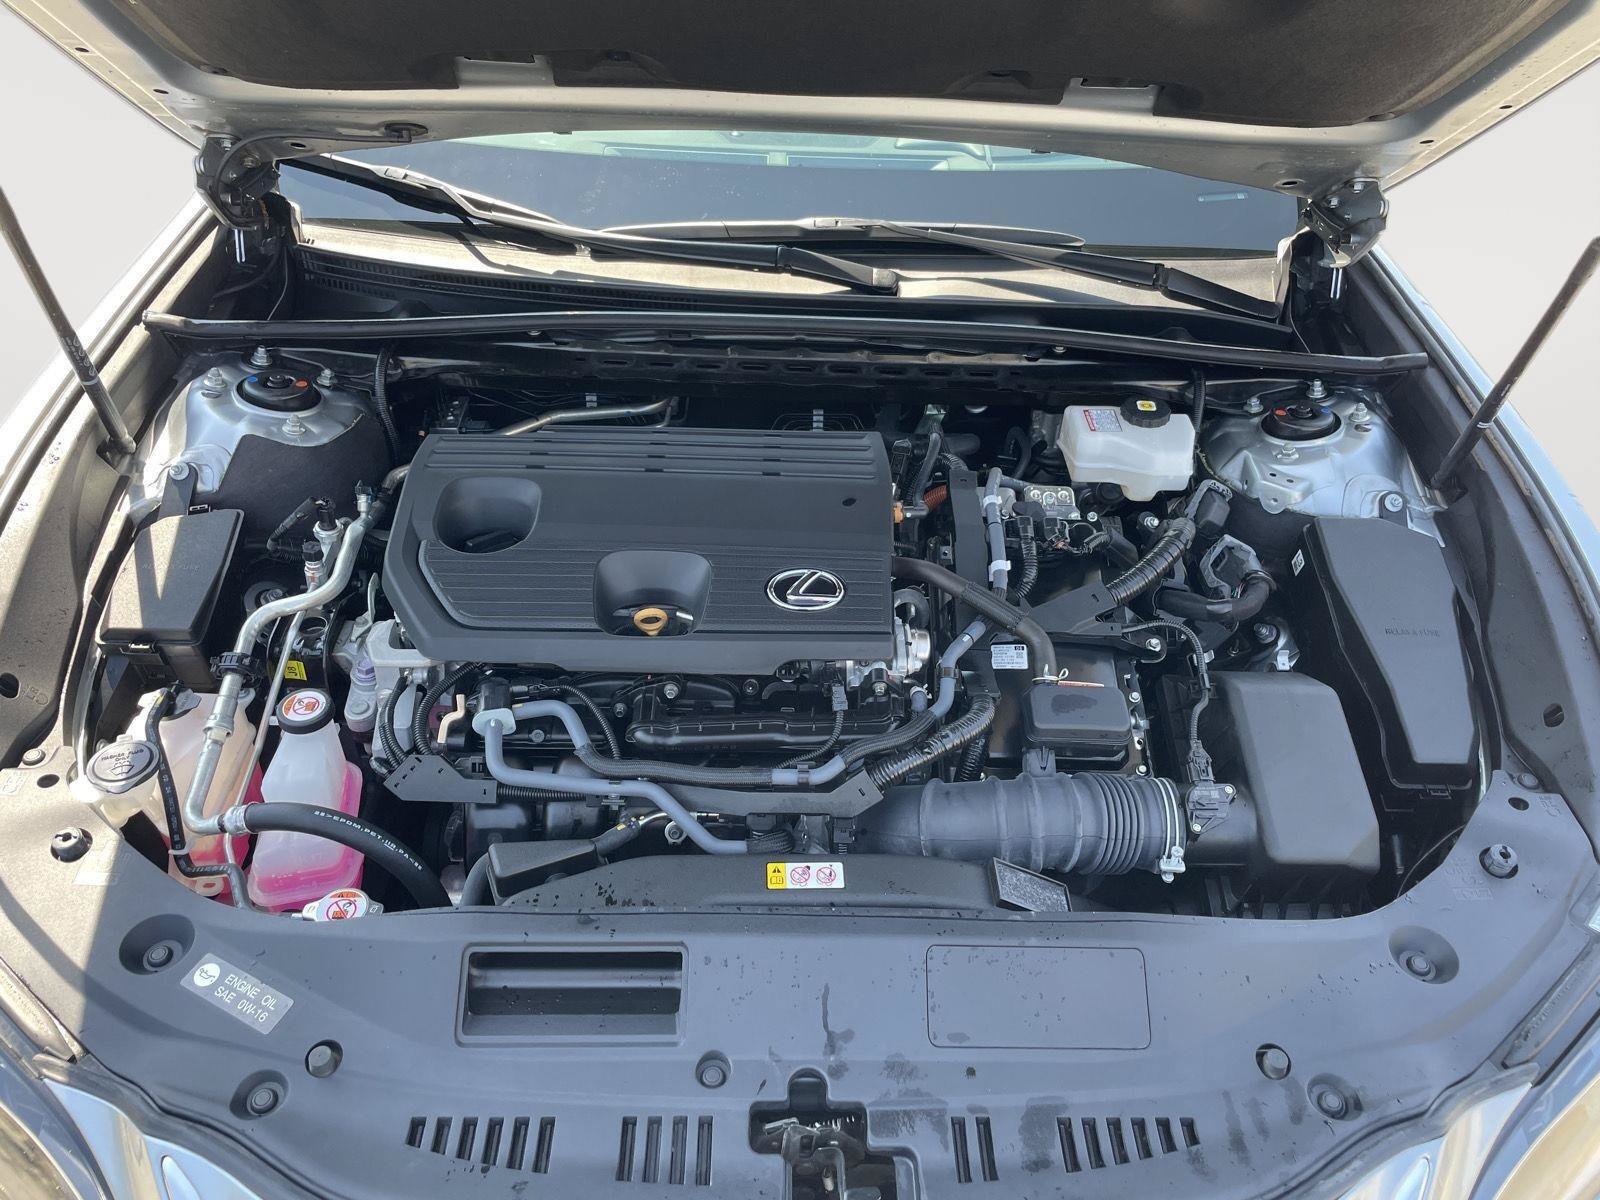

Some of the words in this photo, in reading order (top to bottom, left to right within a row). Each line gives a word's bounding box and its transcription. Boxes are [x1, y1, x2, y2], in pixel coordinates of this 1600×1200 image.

[214, 985, 236, 1003] SAE
[237, 999, 268, 1022] 0W-16
[225, 973, 260, 999] ENGINE
[261, 995, 278, 1011] OIL
